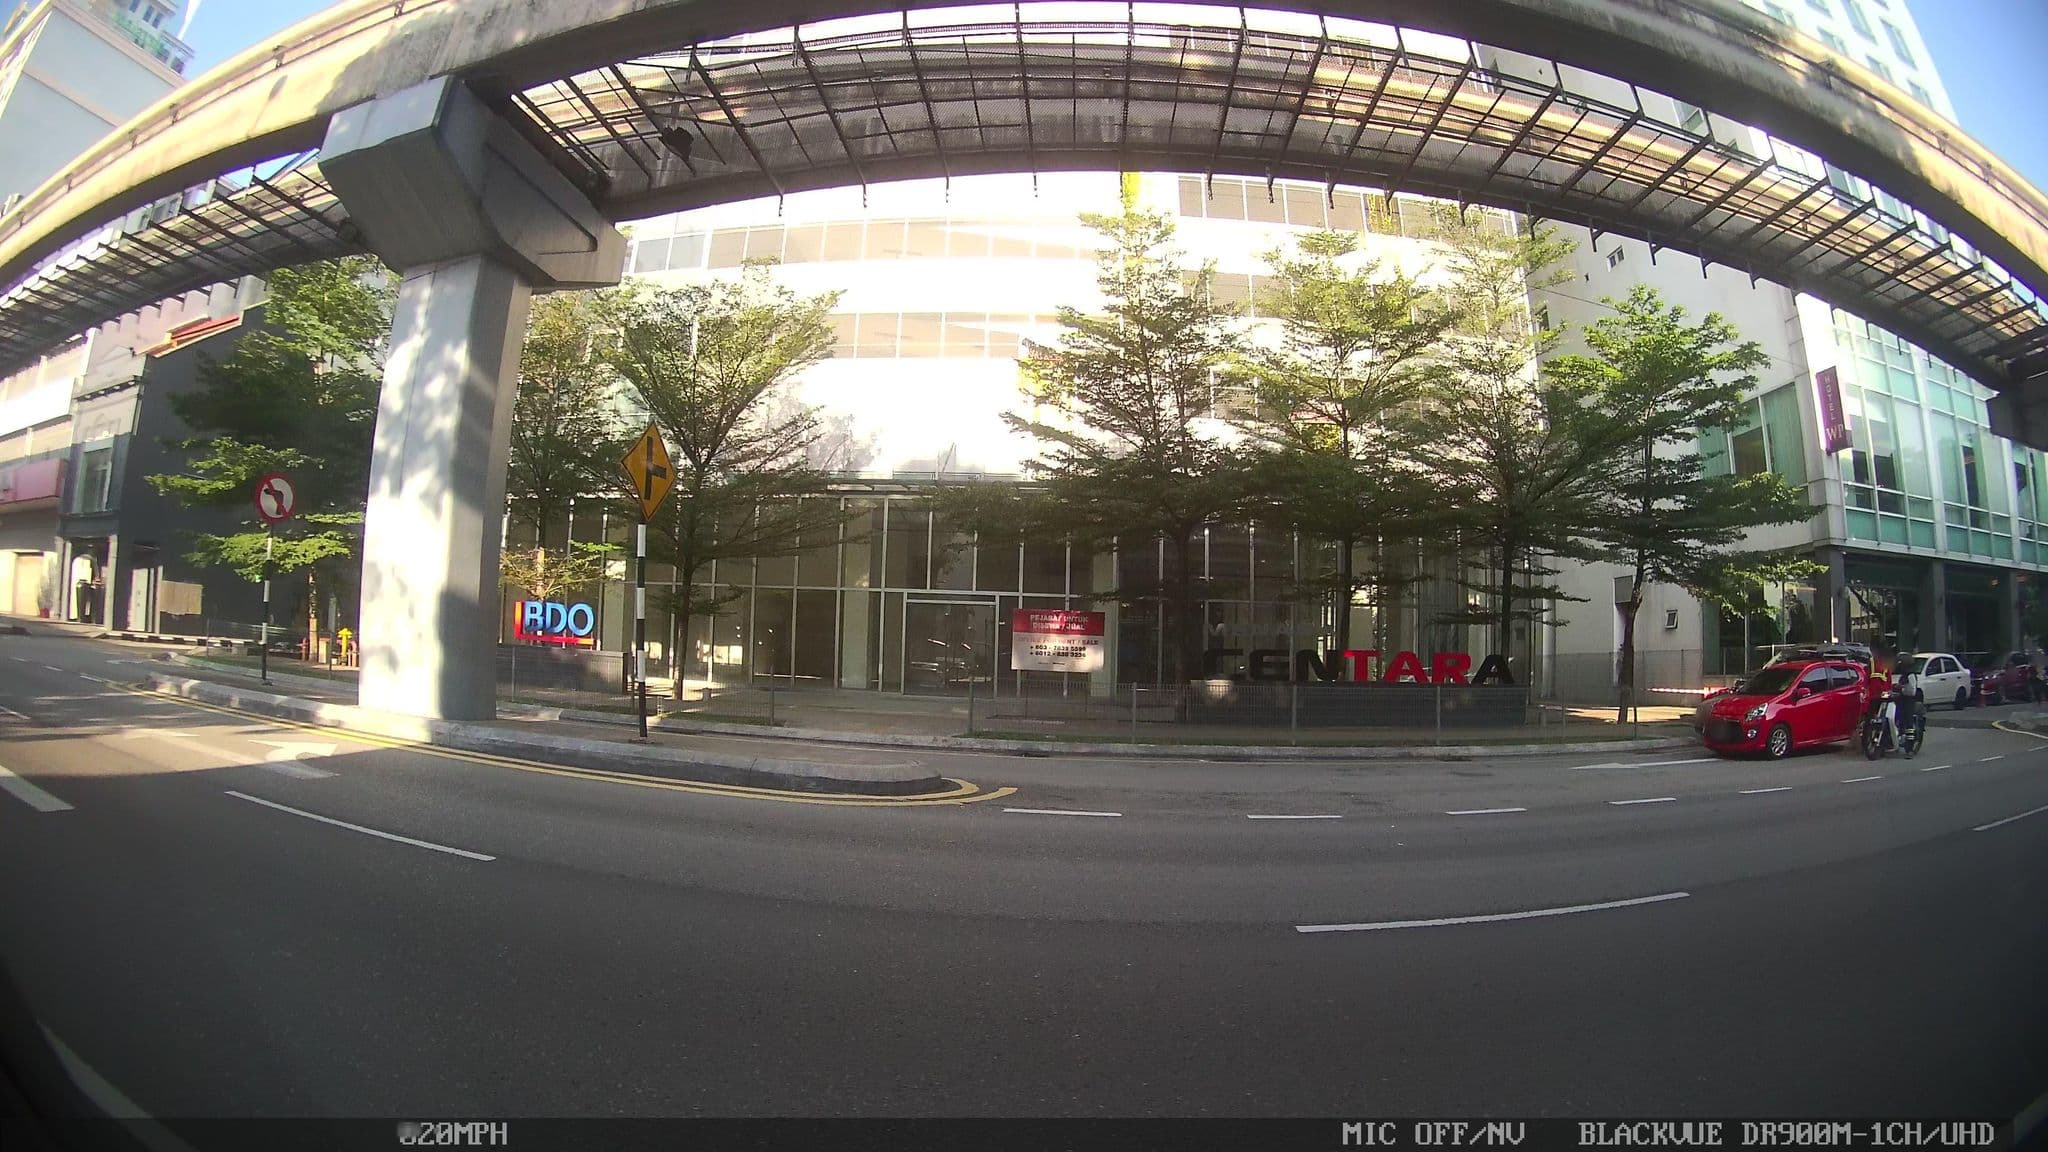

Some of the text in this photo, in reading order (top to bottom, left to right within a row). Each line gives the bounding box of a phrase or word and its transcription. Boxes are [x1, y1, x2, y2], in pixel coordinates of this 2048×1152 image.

[1824, 375, 1836, 421] HOTEL
[524, 600, 595, 637] BDO
[1201, 648, 1516, 686] CENTARA
